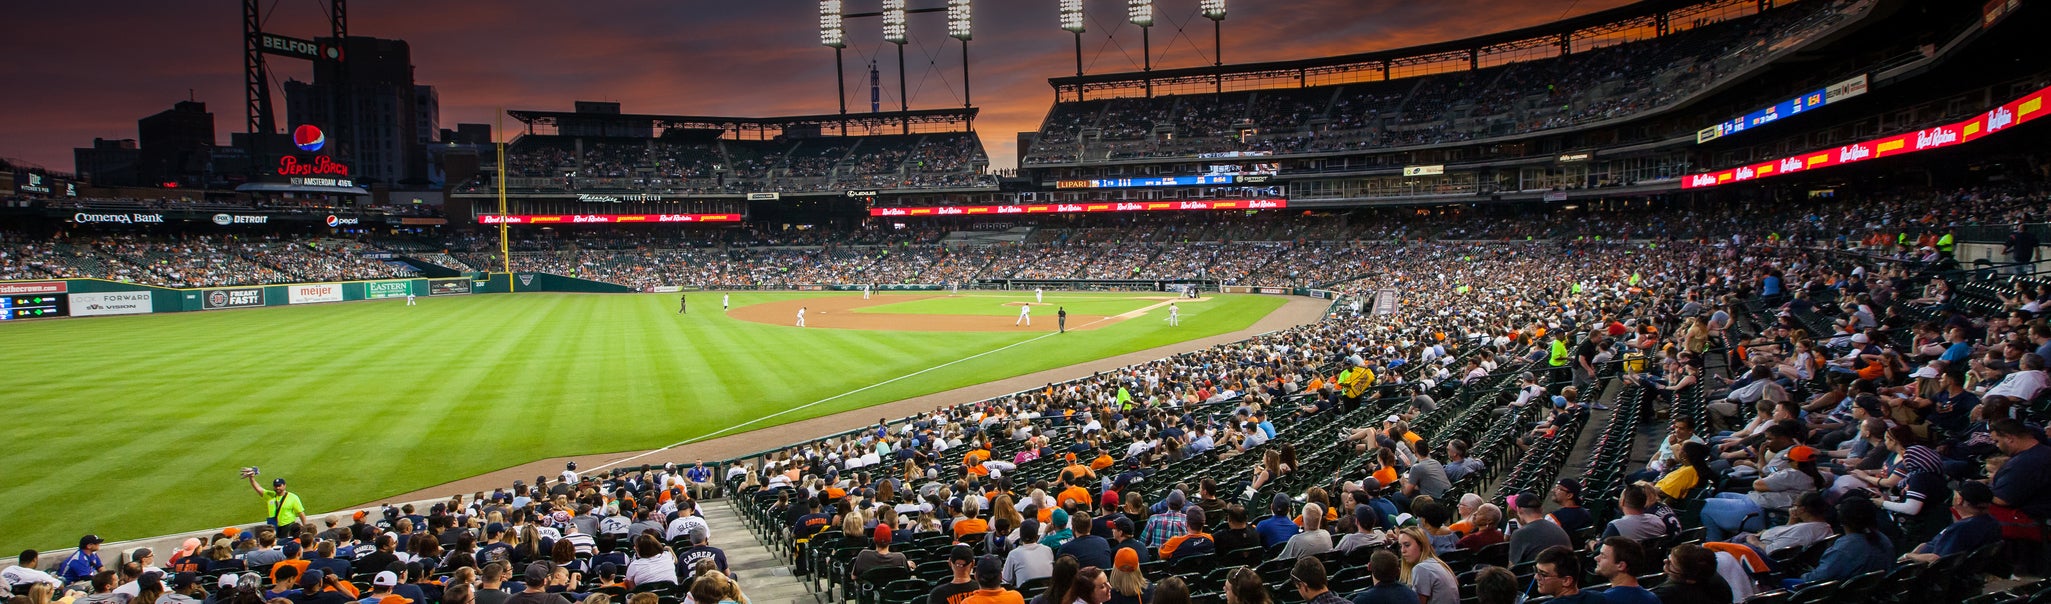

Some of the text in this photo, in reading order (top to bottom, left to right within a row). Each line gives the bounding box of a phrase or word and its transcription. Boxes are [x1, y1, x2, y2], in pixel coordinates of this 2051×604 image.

[263, 35, 318, 56] BELFOR
[1916, 130, 1934, 150] Red
[1932, 126, 1957, 147] Robin
[1840, 146, 1854, 163] Red
[1852, 143, 1870, 160] Robin
[277, 154, 349, 177] PEPSI PORCH
[290, 177, 304, 186] NEW
[304, 177, 337, 187] AMSTERDAM
[882, 208, 892, 216] Red
[1057, 204, 1069, 212] Red
[1069, 204, 1082, 212] Robin
[1117, 203, 1128, 211] Red
[1128, 202, 1142, 210] Robin
[1180, 201, 1192, 210] Red
[1192, 201, 1207, 209] Robin
[1248, 200, 1261, 208] Red
[1261, 200, 1277, 208] Robin
[134, 213, 164, 223] Bank
[234, 215, 268, 224] DETROIT
[338, 217, 359, 226] pepsi
[659, 214, 672, 222] Red
[300, 285, 332, 297] meijer
[371, 282, 407, 291] EASTERN
[104, 294, 150, 302] FORWARD
[229, 296, 259, 305] FAST!
[677, 521, 701, 533] IGLESIA
[684, 551, 716, 565] CABRERA
